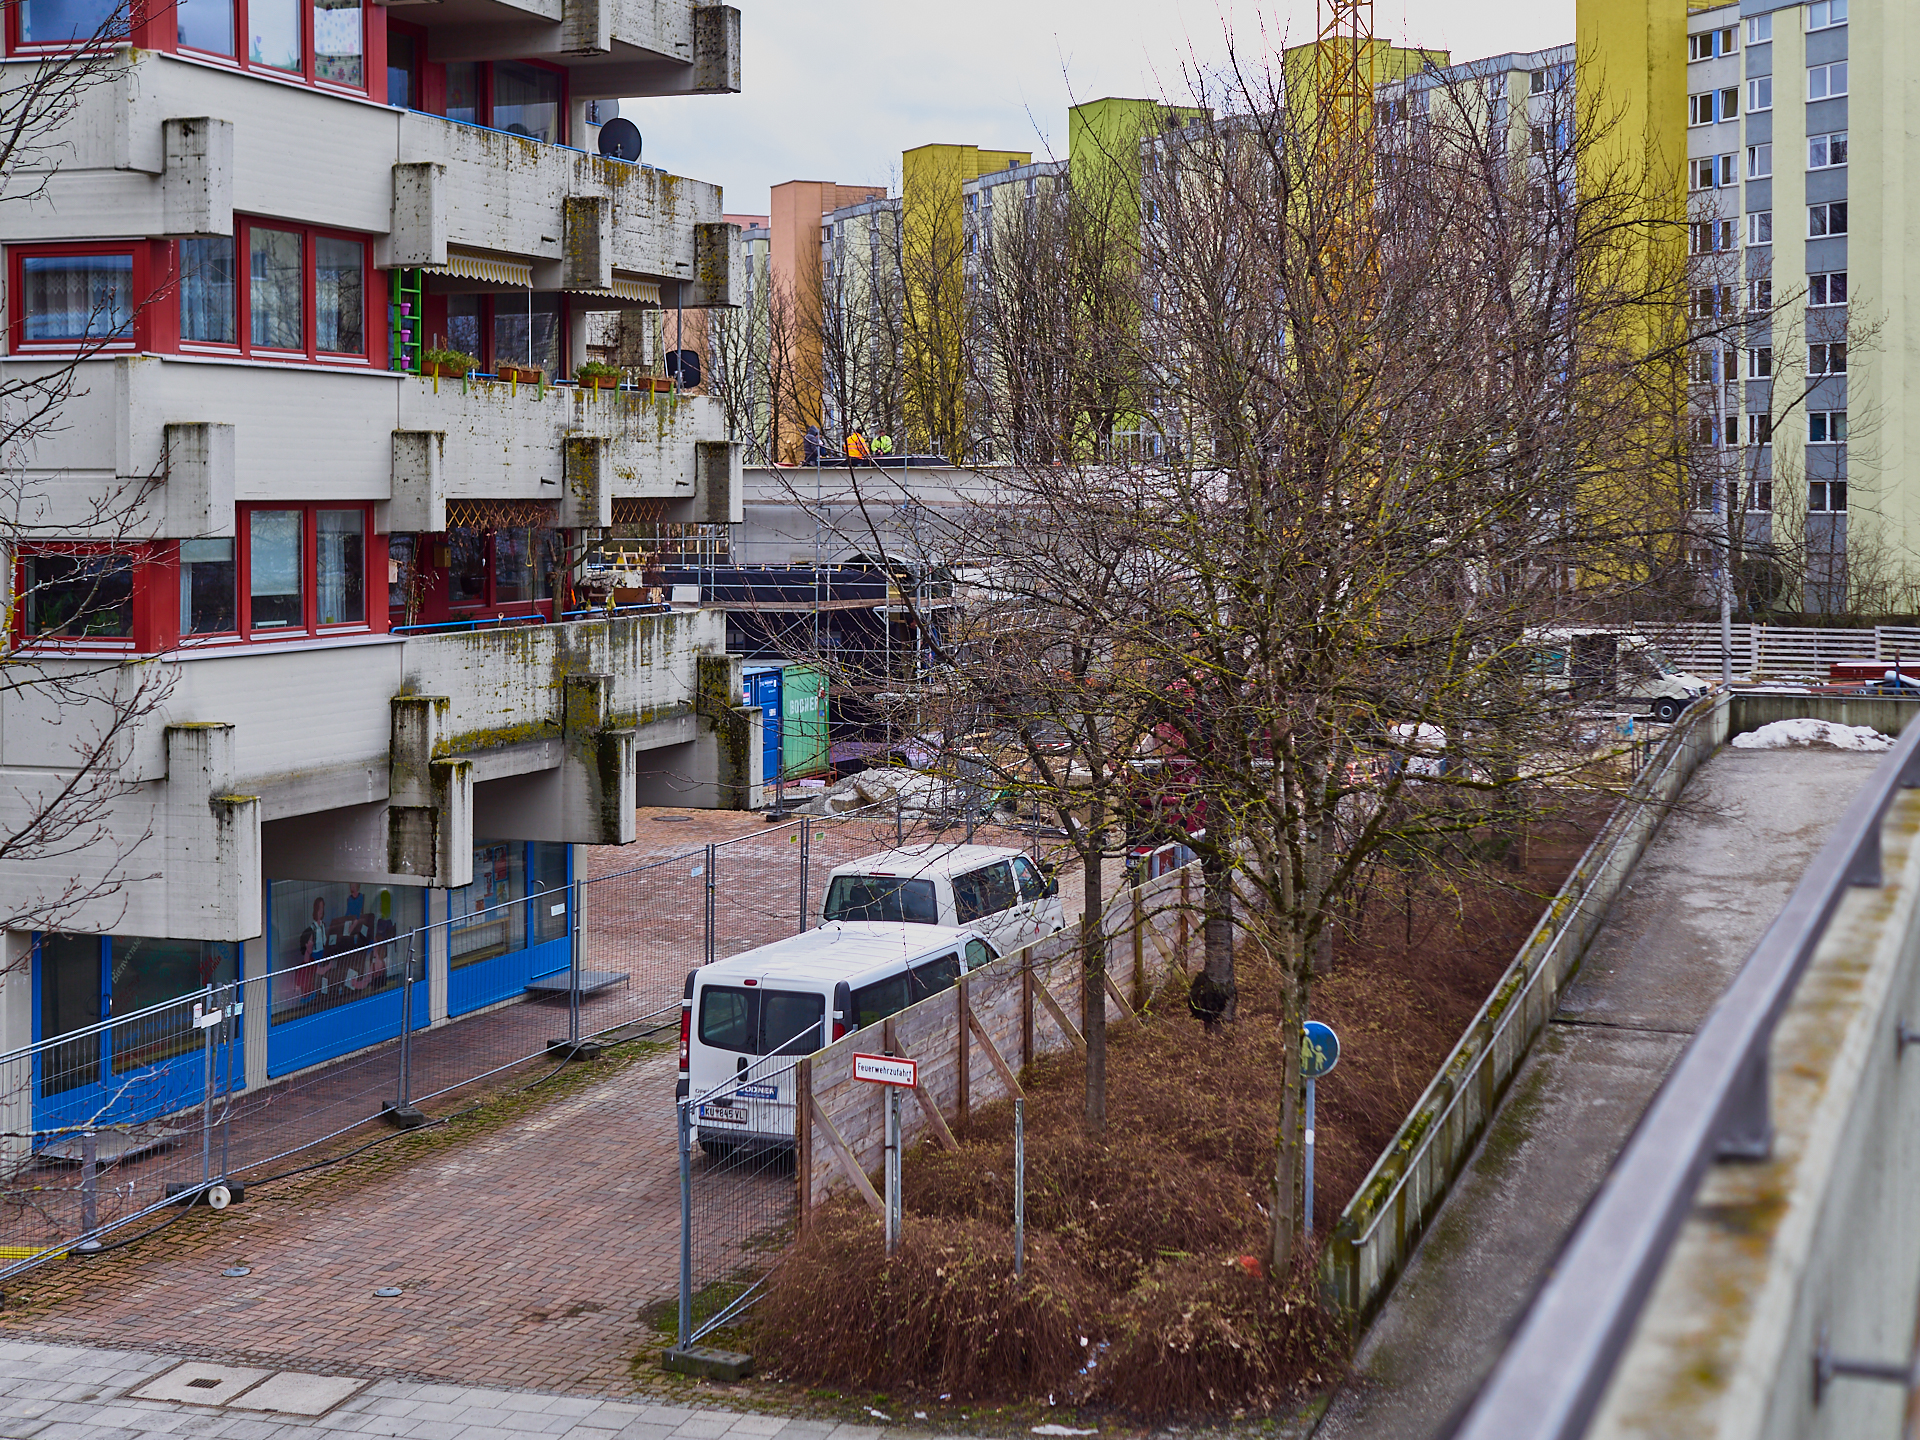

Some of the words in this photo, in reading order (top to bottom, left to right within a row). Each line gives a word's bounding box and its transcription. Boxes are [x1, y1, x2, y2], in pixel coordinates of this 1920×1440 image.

[111, 937, 142, 984] Bienvenue
[857, 1062, 912, 1078] Feuerwehrzufahrt
[719, 1108, 734, 1119] 845
